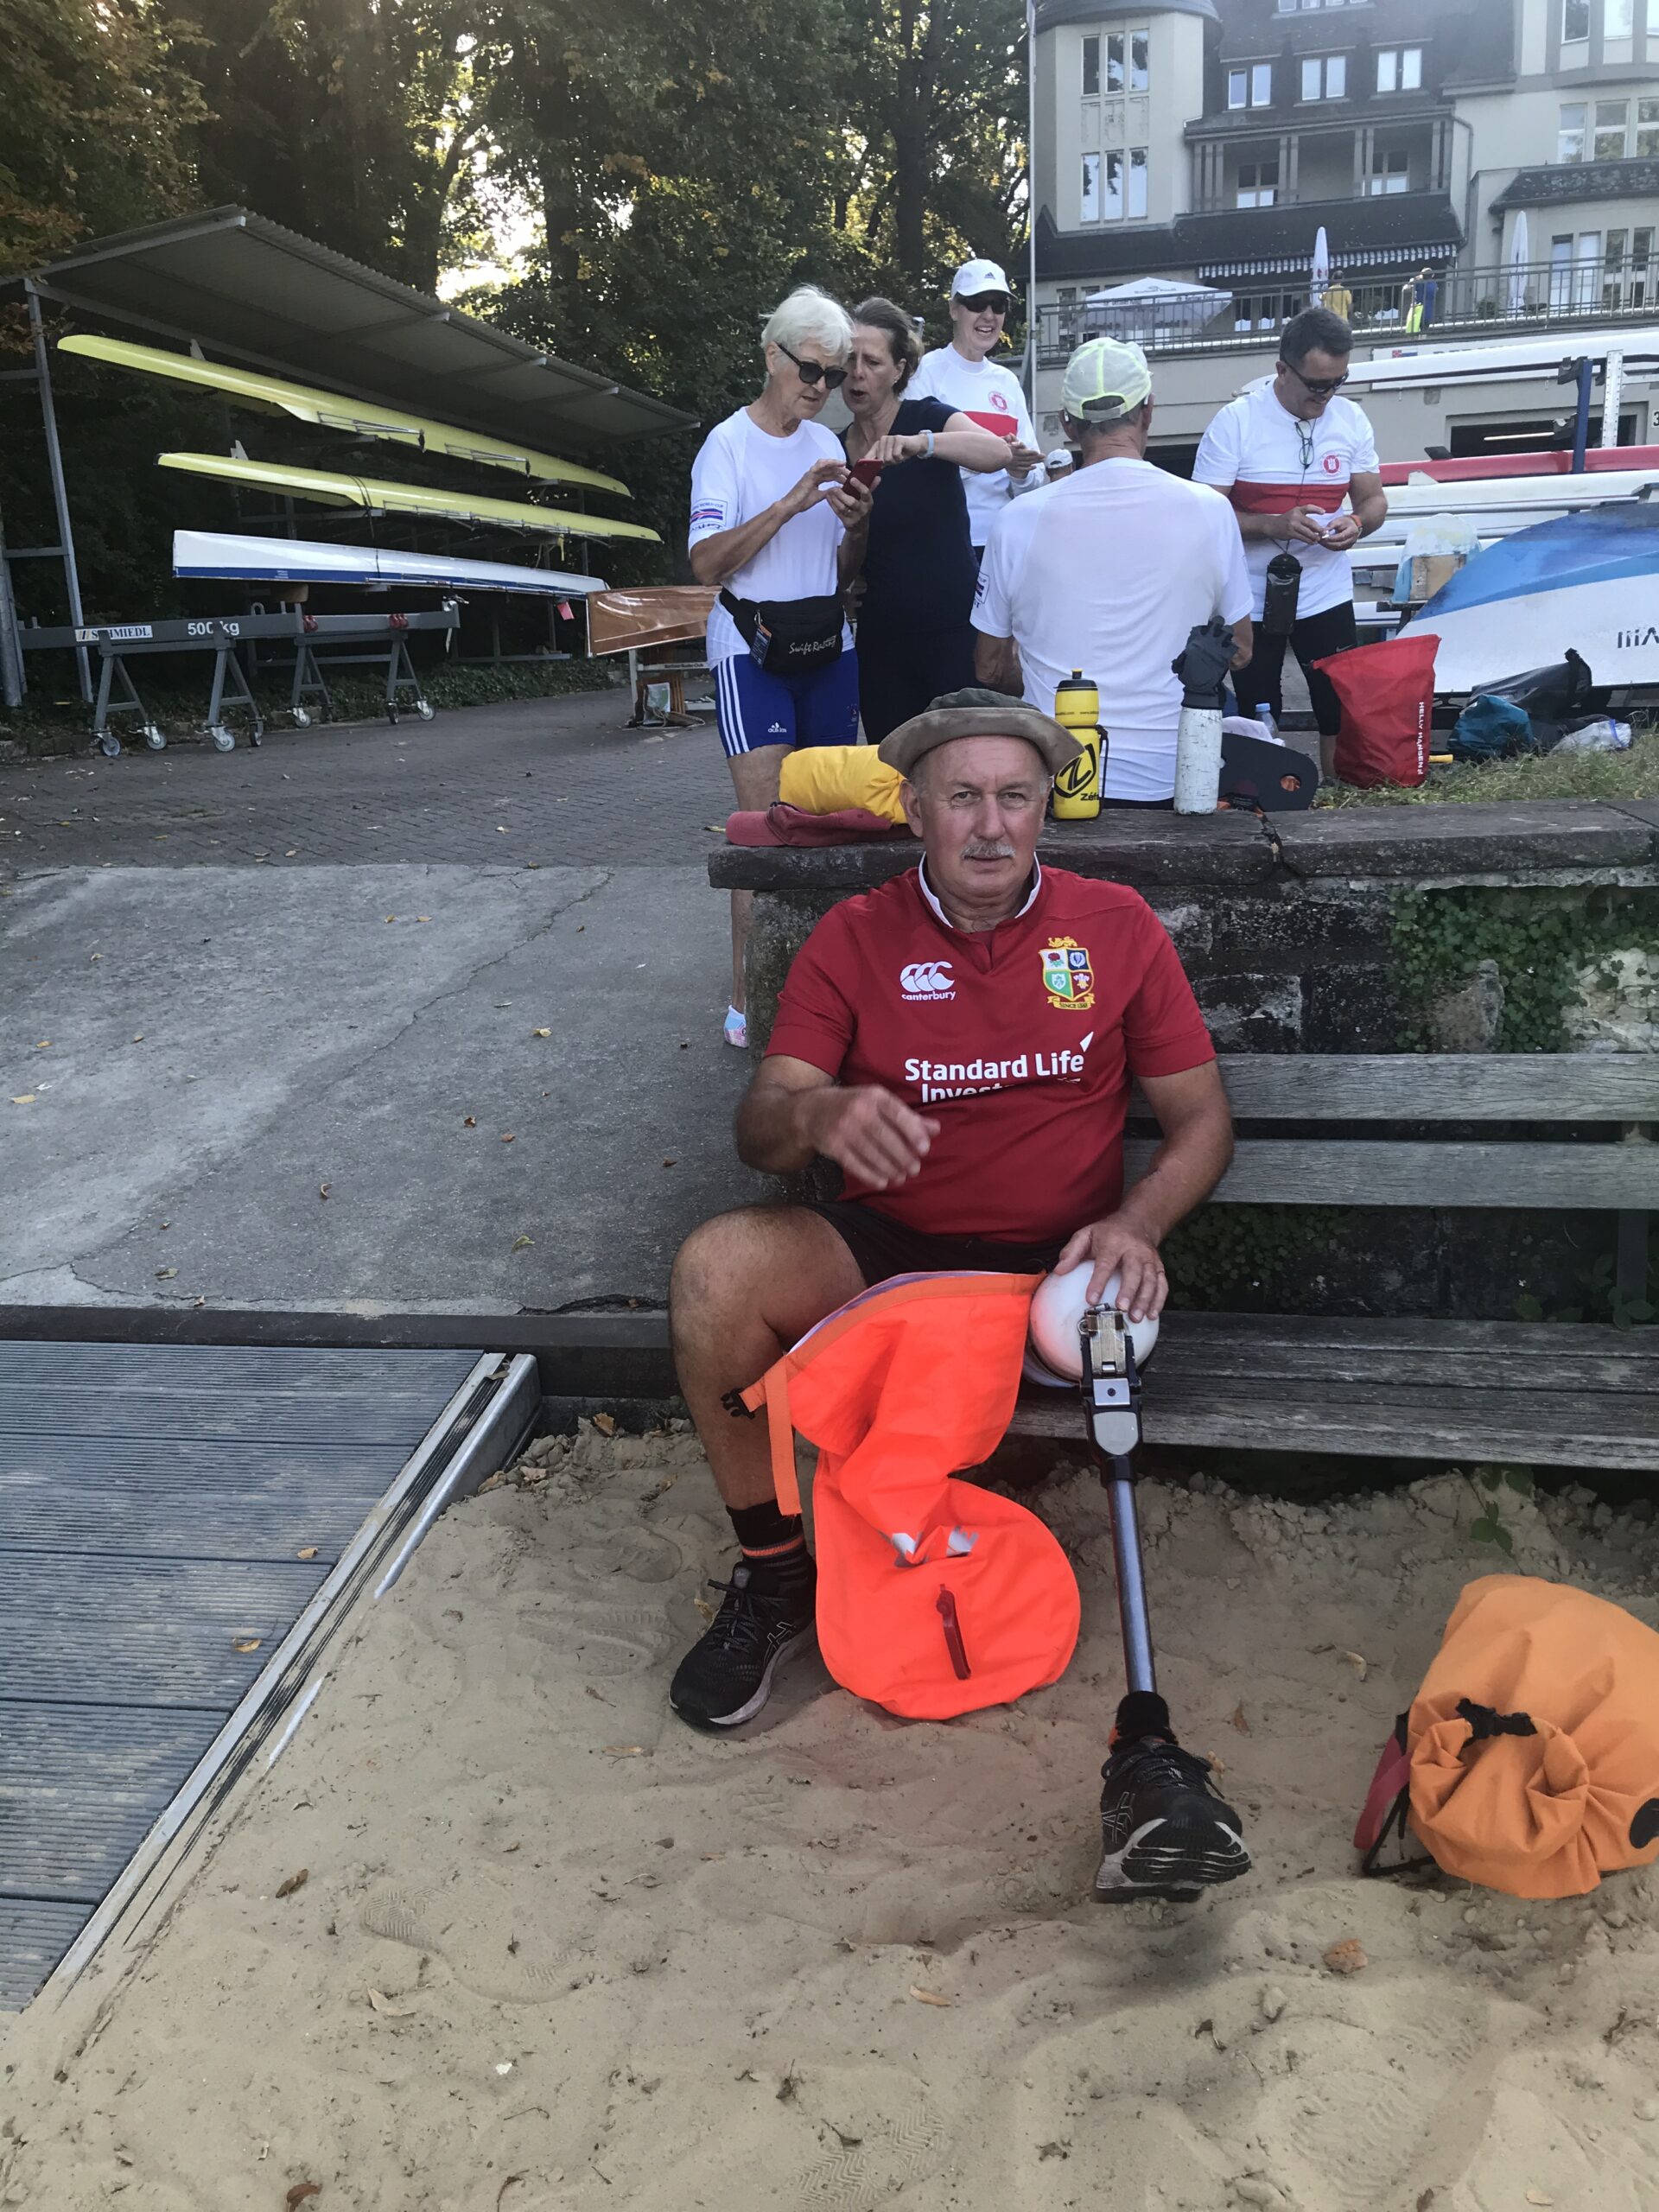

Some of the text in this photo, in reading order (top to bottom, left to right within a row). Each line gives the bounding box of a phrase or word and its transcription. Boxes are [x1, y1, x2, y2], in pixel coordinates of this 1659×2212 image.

[92, 626, 150, 639] SHMIEDL
[901, 991, 956, 1001] canterbury
[905, 1050, 1084, 1081] Standard Life
